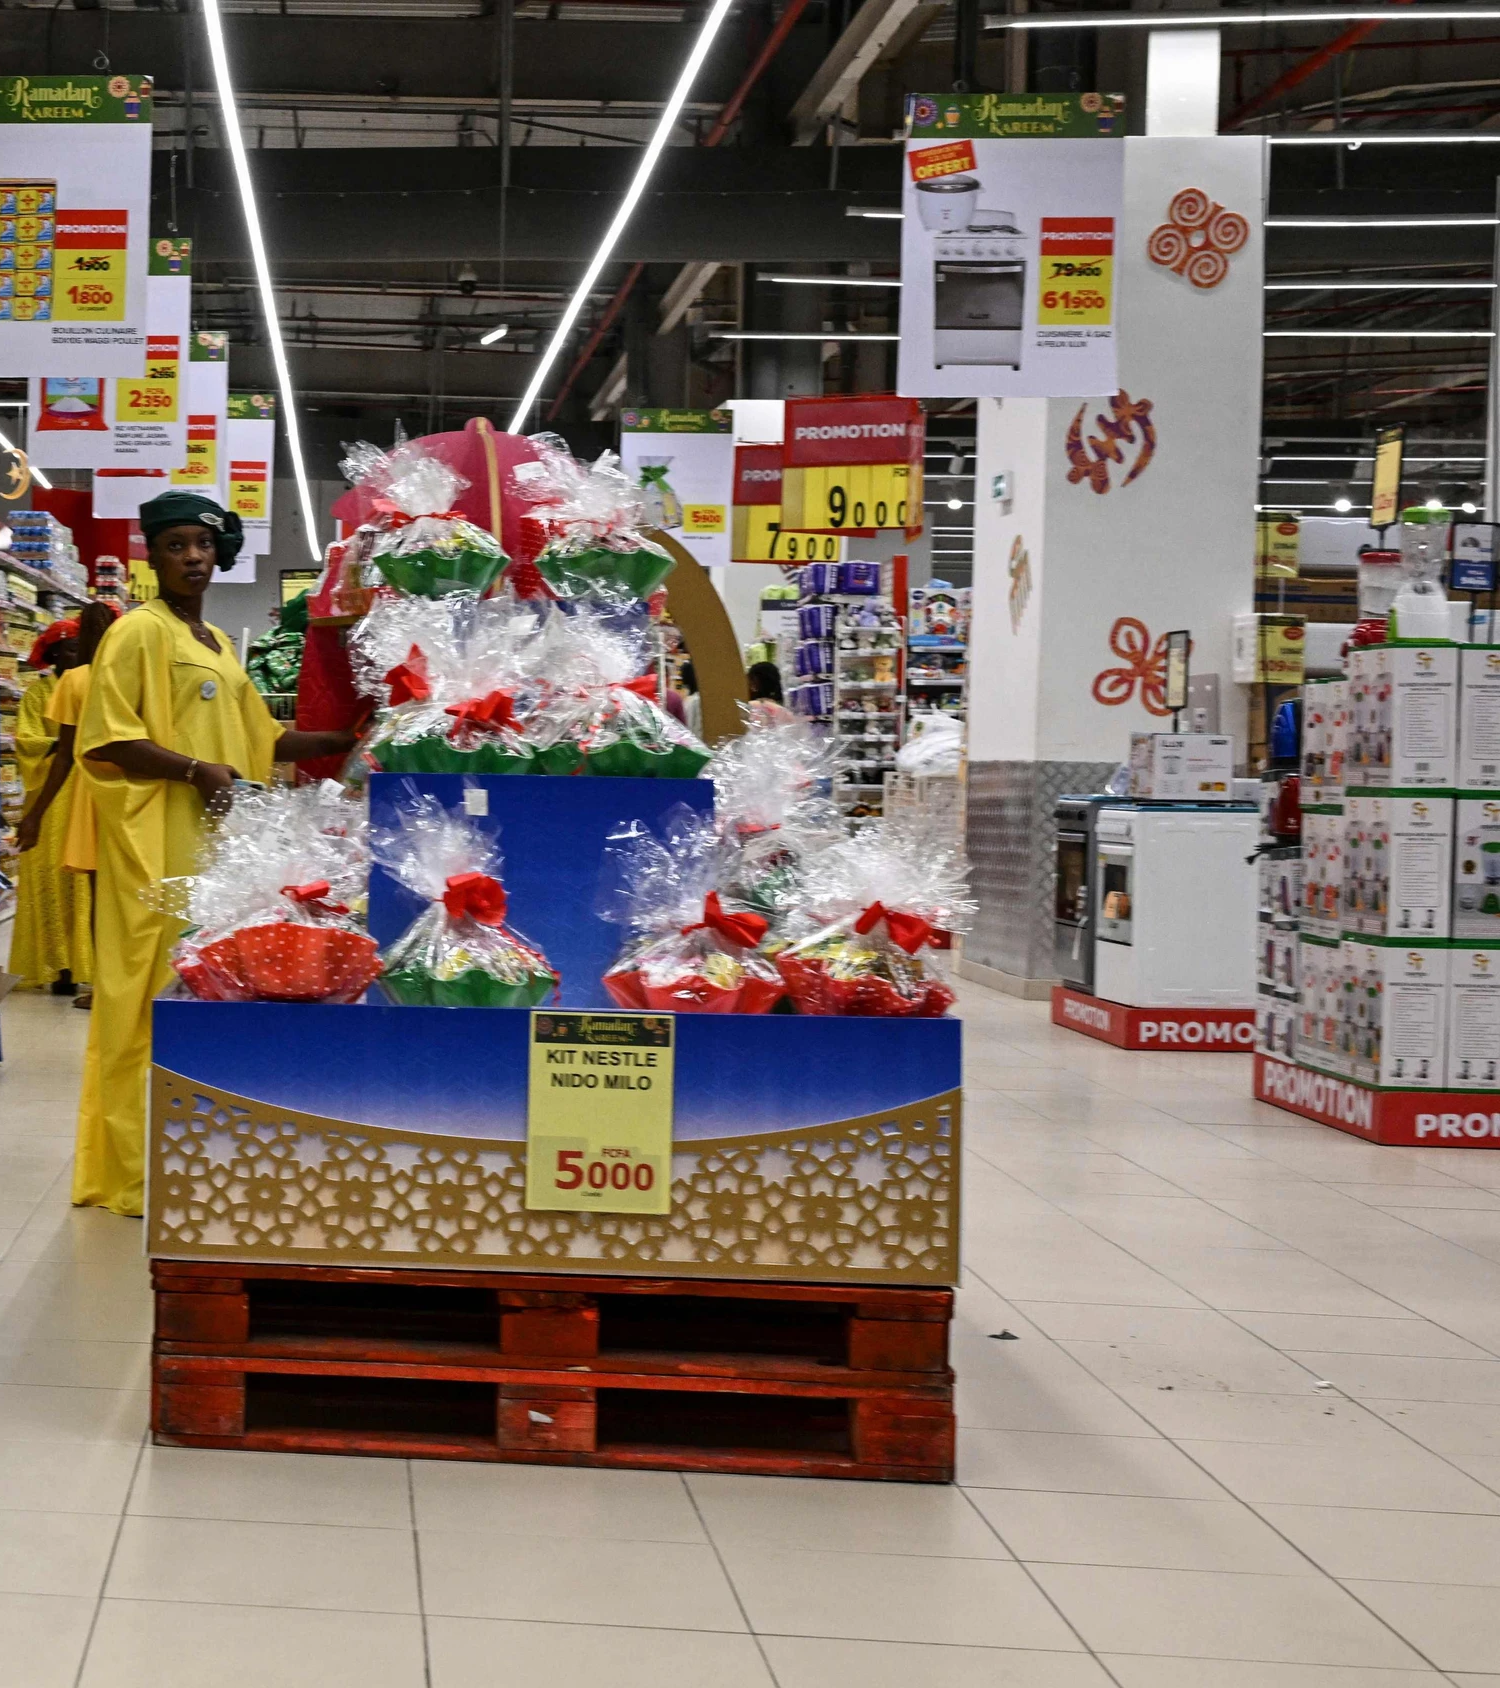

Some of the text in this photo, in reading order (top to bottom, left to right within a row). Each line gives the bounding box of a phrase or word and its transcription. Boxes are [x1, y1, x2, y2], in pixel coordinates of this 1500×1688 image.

[8, 77, 103, 107] Ramadan
[22, 107, 84, 120] KAREEM
[973, 94, 1073, 124] Ramadan
[989, 122, 1056, 136] KAREEM
[915, 157, 971, 178] OFFERT
[55, 225, 127, 234] PROMOTION
[1041, 232, 1114, 240] PROMOTION
[67, 286, 114, 304] 1800
[1042, 291, 1105, 309] 61900
[129, 390, 173, 408] 2350
[794, 423, 906, 440] PROMOTION
[1063, 999, 1111, 1033] PROMOTION
[579, 1016, 638, 1036] Ramadan
[547, 1050, 658, 1067] KIT NESTLE
[551, 1073, 652, 1091] NIDO MILO
[1263, 1061, 1374, 1130] PROMOTION
[601, 1148, 632, 1159] FCFA
